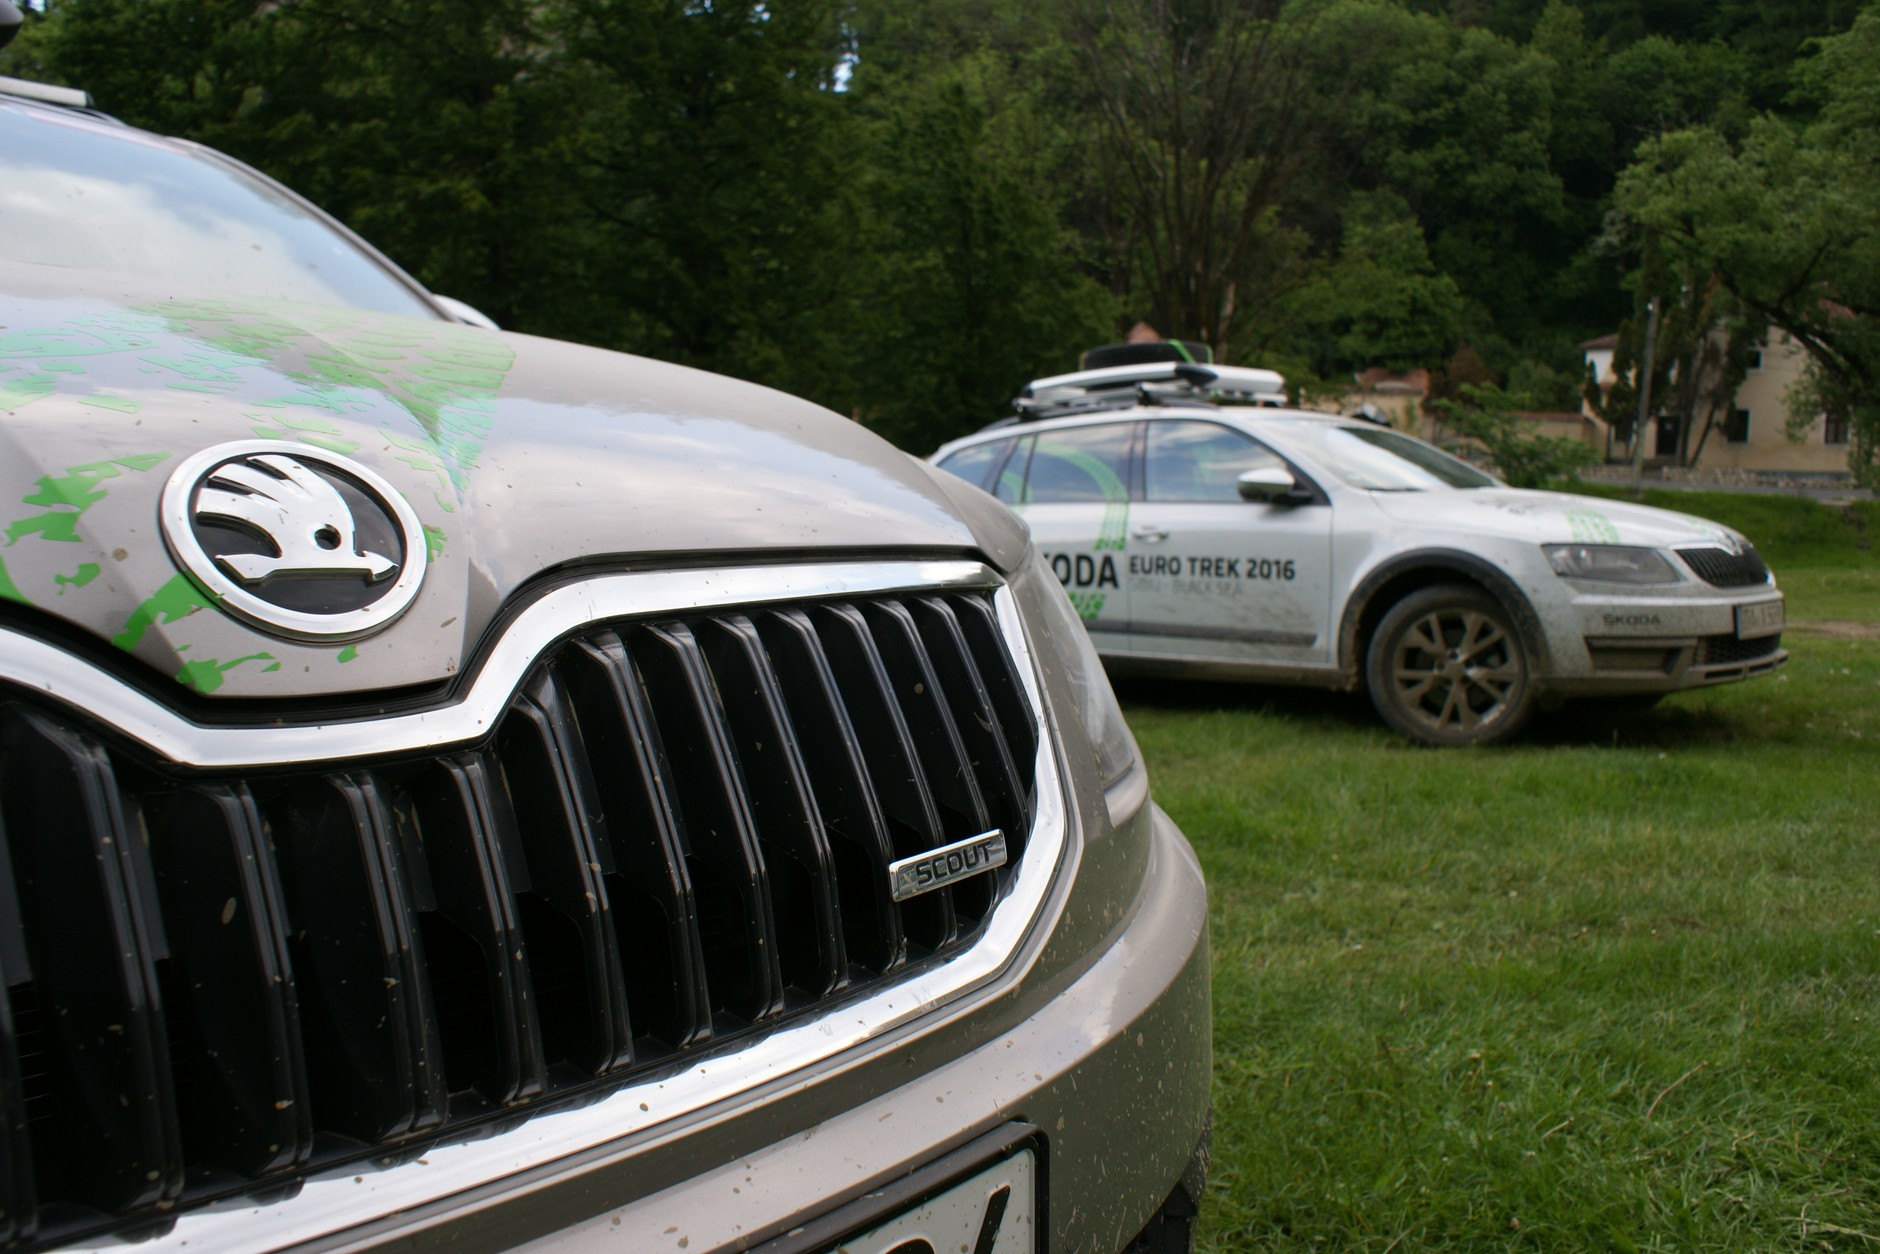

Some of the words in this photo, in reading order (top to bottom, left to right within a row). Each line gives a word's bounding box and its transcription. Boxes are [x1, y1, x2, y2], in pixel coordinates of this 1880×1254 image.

[1045, 554, 1119, 588] ODA
[1130, 556, 1181, 576] EURO
[1188, 558, 1240, 578] TREK
[1246, 559, 1296, 580] 2016
[915, 841, 991, 885] SCOUT
